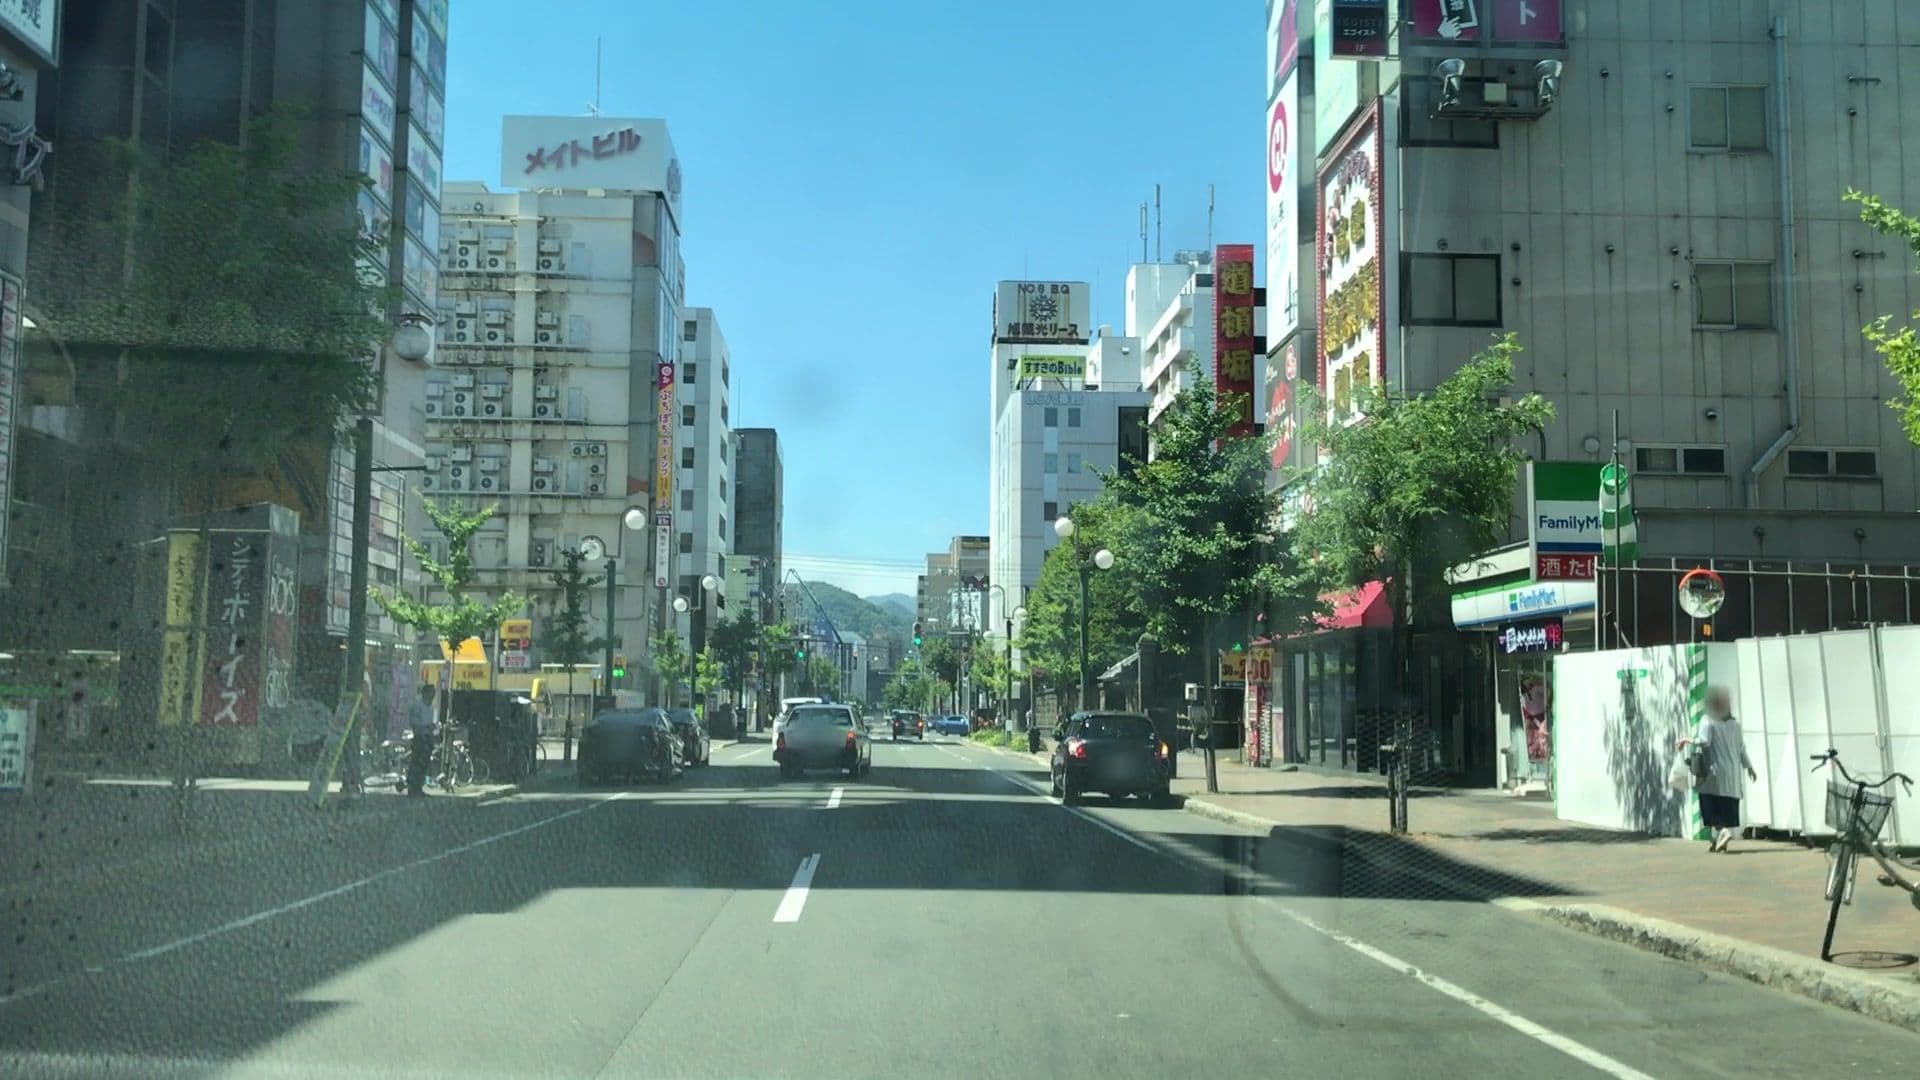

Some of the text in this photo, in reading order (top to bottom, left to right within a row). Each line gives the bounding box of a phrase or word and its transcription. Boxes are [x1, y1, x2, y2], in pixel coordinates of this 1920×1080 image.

[524, 127, 641, 175] メイトビル
[1538, 514, 1601, 533] FamilyM
[1519, 588, 1556, 608] FamilyMart
[215, 537, 250, 724] シティボーイズ
